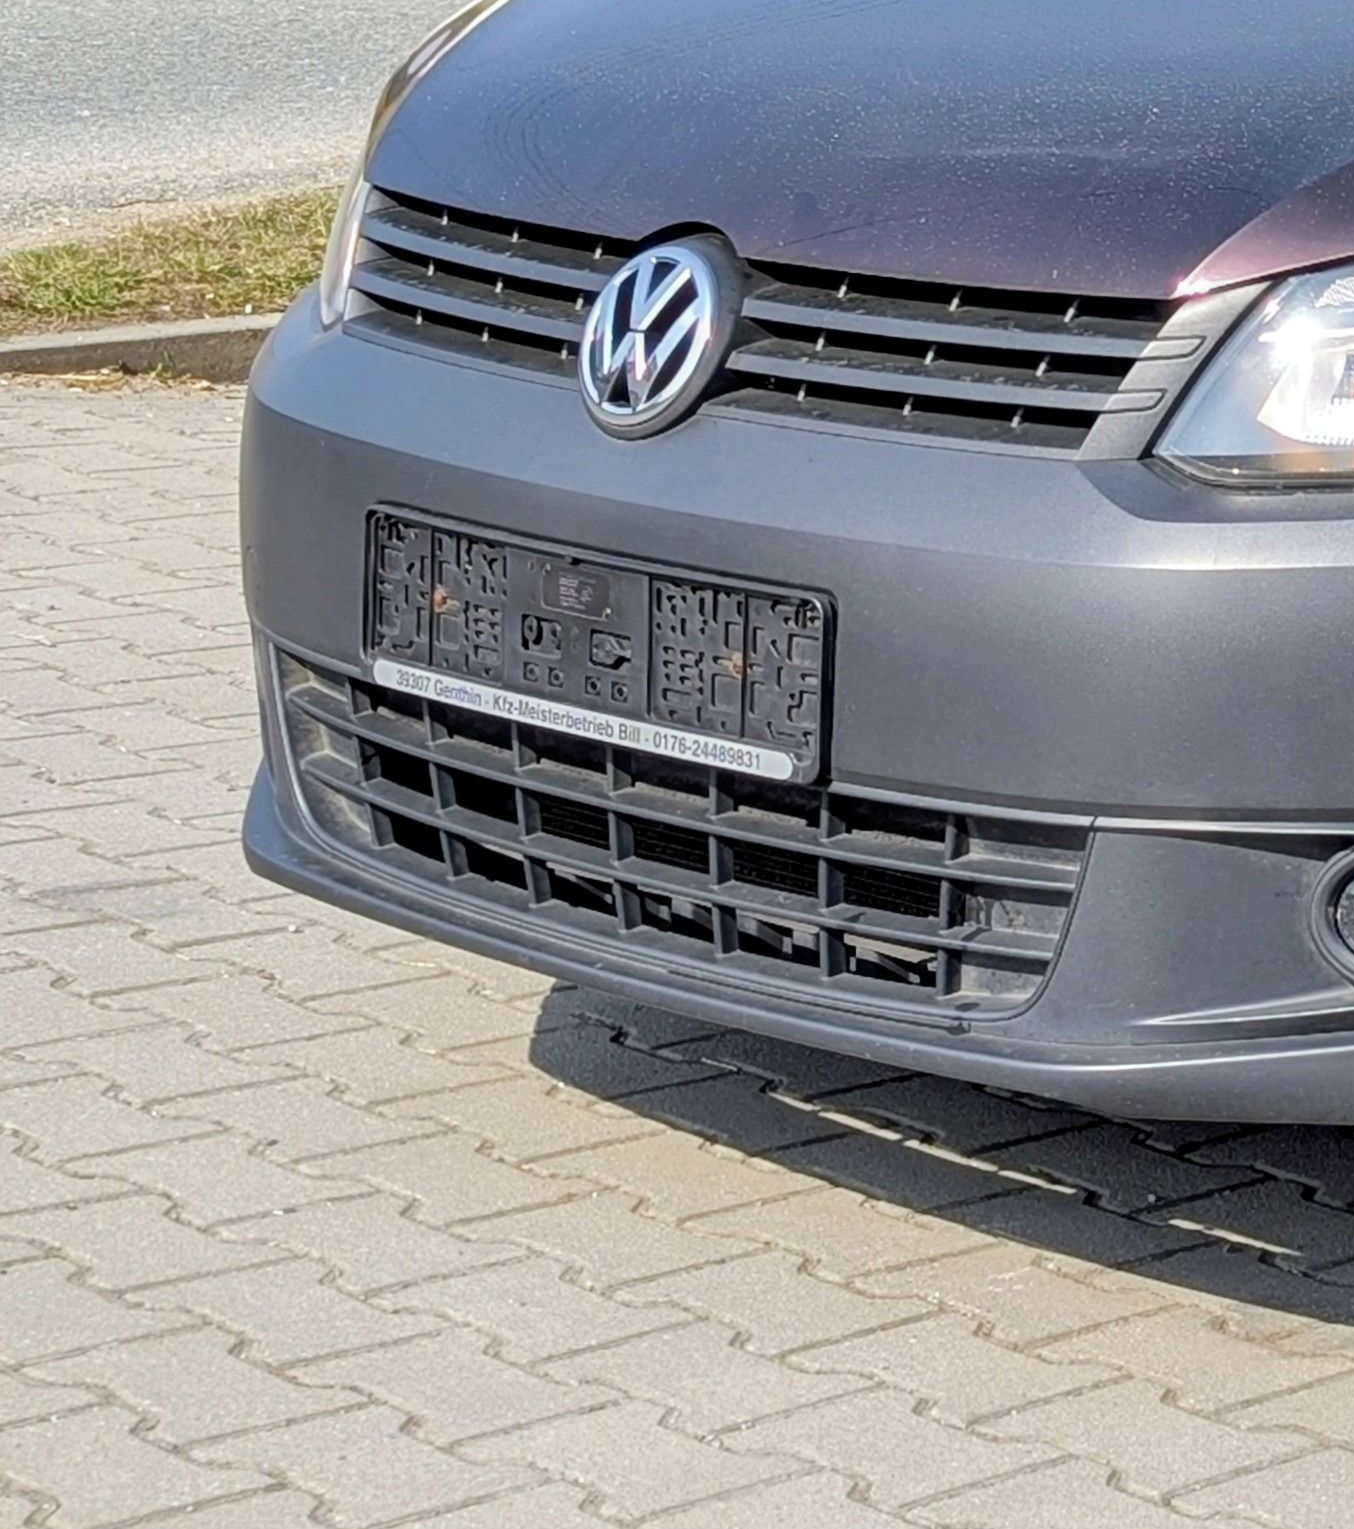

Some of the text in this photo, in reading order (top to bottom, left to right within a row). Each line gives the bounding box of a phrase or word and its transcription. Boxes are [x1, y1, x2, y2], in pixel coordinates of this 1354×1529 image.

[396, 669, 431, 693] 39307
[434, 681, 482, 707] Genthin
[493, 693, 615, 738] Kfz-Meisterbetrieb
[618, 723, 641, 745] Bill
[653, 731, 761, 770] 0176-24489831
